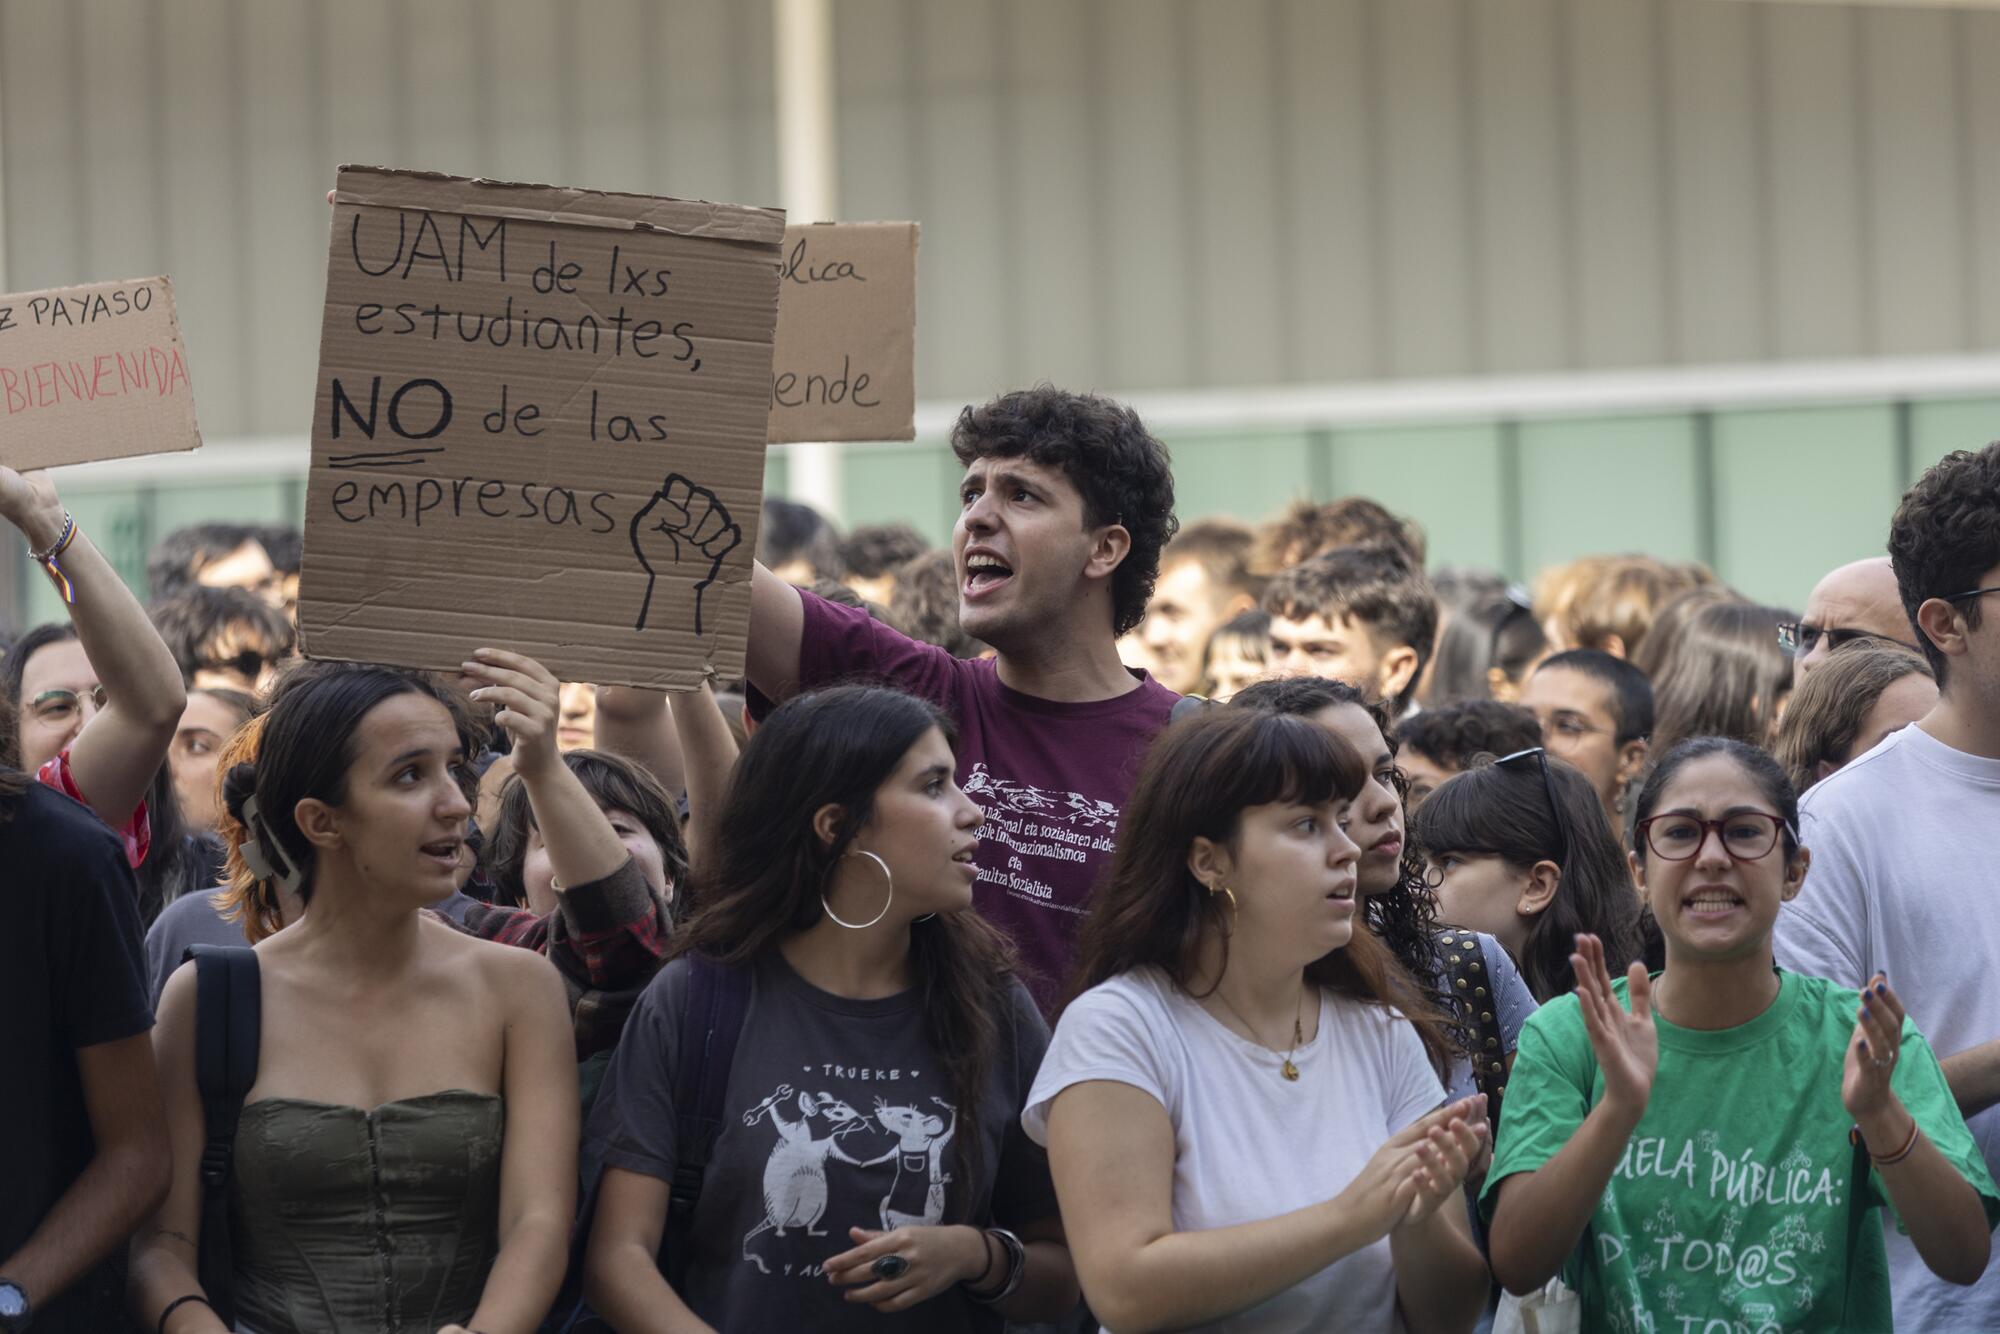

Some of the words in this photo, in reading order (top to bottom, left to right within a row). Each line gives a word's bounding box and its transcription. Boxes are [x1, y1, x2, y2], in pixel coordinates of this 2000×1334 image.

[352, 213, 507, 282] UAM
[532, 241, 582, 295] de
[609, 245, 672, 297] lxs
[28, 287, 152, 327] PAYASO
[355, 297, 702, 372] estudiantes,
[0, 346, 189, 414] BIENVENIDA
[330, 376, 453, 440] NO
[482, 384, 547, 436] de
[590, 389, 668, 443] las
[331, 476, 616, 534] empresas
[973, 822, 995, 841] gile
[1024, 821, 1038, 836] eta
[1040, 824, 1091, 848] sozialaren
[971, 862, 1008, 886] aultza
[1008, 872, 1053, 899] Sozialista
[1008, 856, 1022, 871] eta
[822, 1063, 901, 1080] TRUEKE
[1710, 1148, 1843, 1207] PÚBLICA:
[1654, 1236, 1797, 1289] TOD@S
